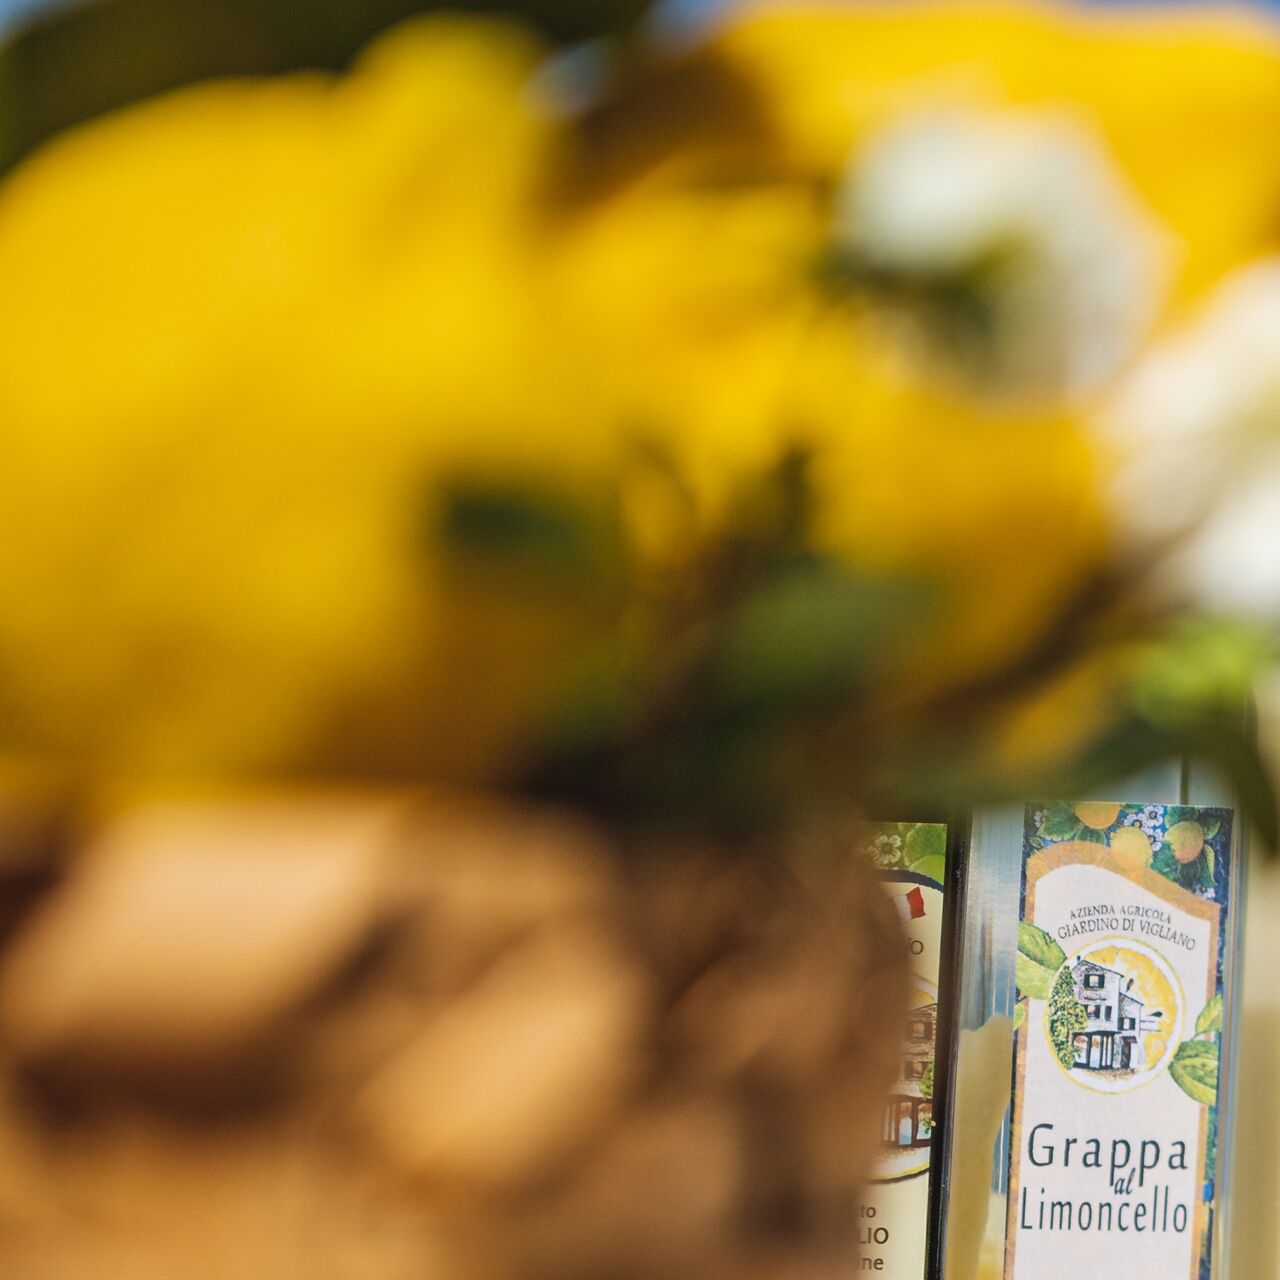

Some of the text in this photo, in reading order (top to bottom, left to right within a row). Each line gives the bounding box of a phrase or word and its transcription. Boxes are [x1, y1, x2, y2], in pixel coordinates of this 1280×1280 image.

[1070, 904, 1171, 923] AZIENDA AGRICOLA
[1057, 917, 1119, 939] GIARDINO
[1122, 918, 1135, 931] DI
[1139, 921, 1196, 950] VIGLIANO
[1028, 1123, 1188, 1187] Grappa
[1113, 1167, 1136, 1195] al
[1020, 1185, 1188, 1233] Limoncello
